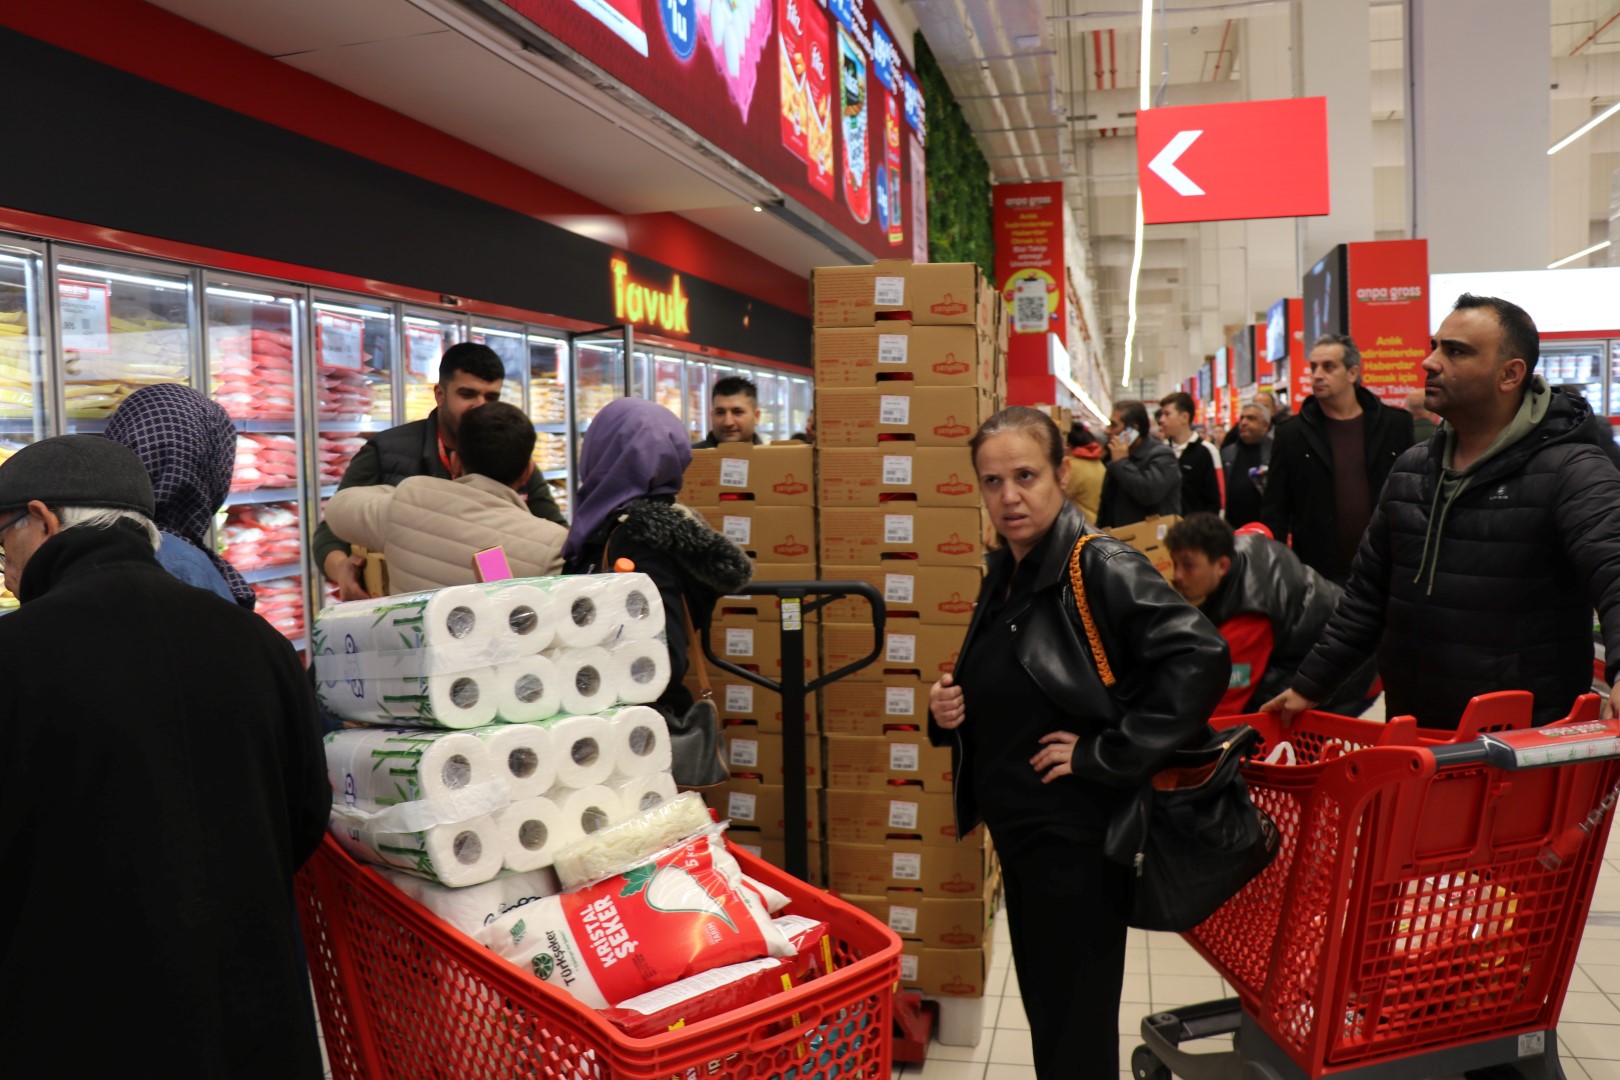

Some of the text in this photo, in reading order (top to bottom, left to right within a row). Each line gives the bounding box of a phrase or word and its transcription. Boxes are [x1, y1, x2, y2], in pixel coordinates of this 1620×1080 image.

[610, 258, 690, 333] Tavuk
[1357, 286, 1421, 301] anpa gross
[1364, 360, 1416, 370] Haberdar
[580, 904, 618, 968] KRİSTAL
[593, 895, 639, 959] ŞEKER
[545, 930, 576, 987] Türkşeker
